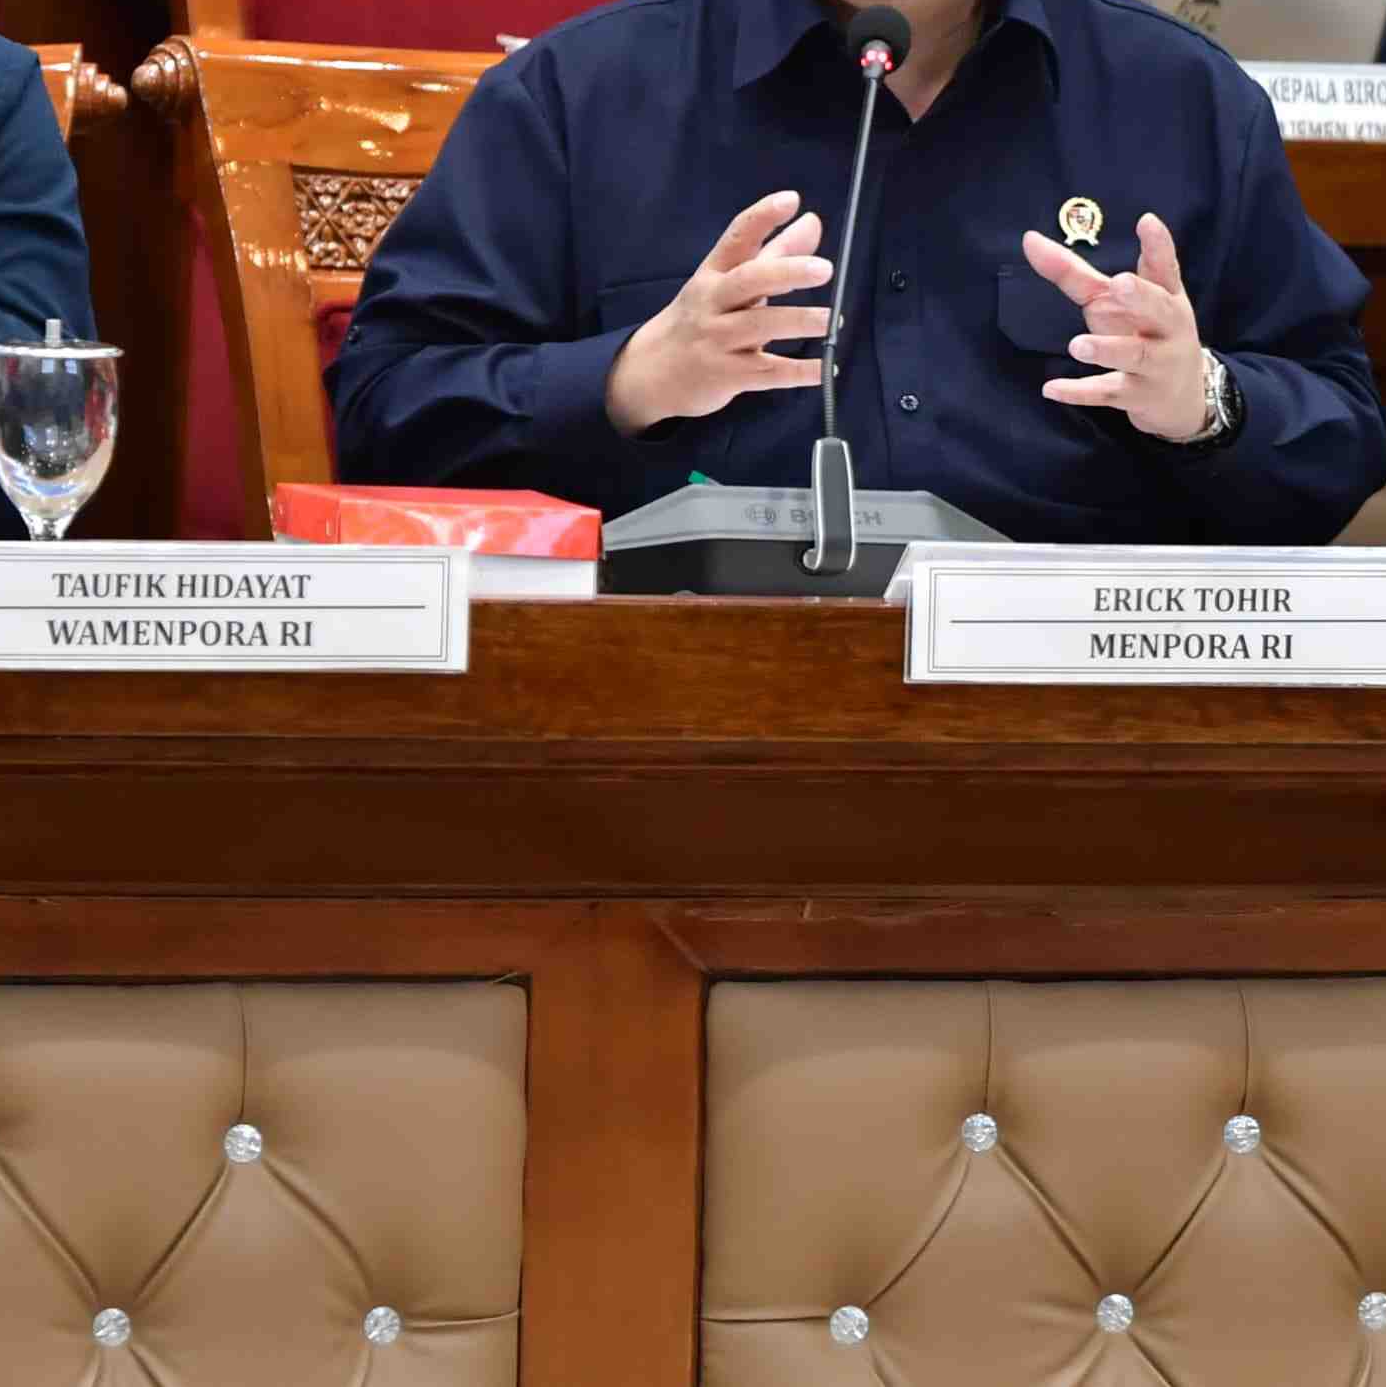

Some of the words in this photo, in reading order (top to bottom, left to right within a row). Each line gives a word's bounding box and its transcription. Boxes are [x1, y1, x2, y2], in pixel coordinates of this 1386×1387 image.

[1268, 77, 1338, 103] KEPALA
[52, 572, 166, 599] TAUFIK
[176, 572, 312, 599] HIDAYAT
[1094, 586, 1186, 613] ERICK
[1193, 587, 1292, 613] TOHIR
[46, 619, 269, 647] WAMENPORA
[280, 621, 313, 647] RI
[1090, 633, 1251, 660] MENPORA
[1261, 634, 1293, 660] RI
